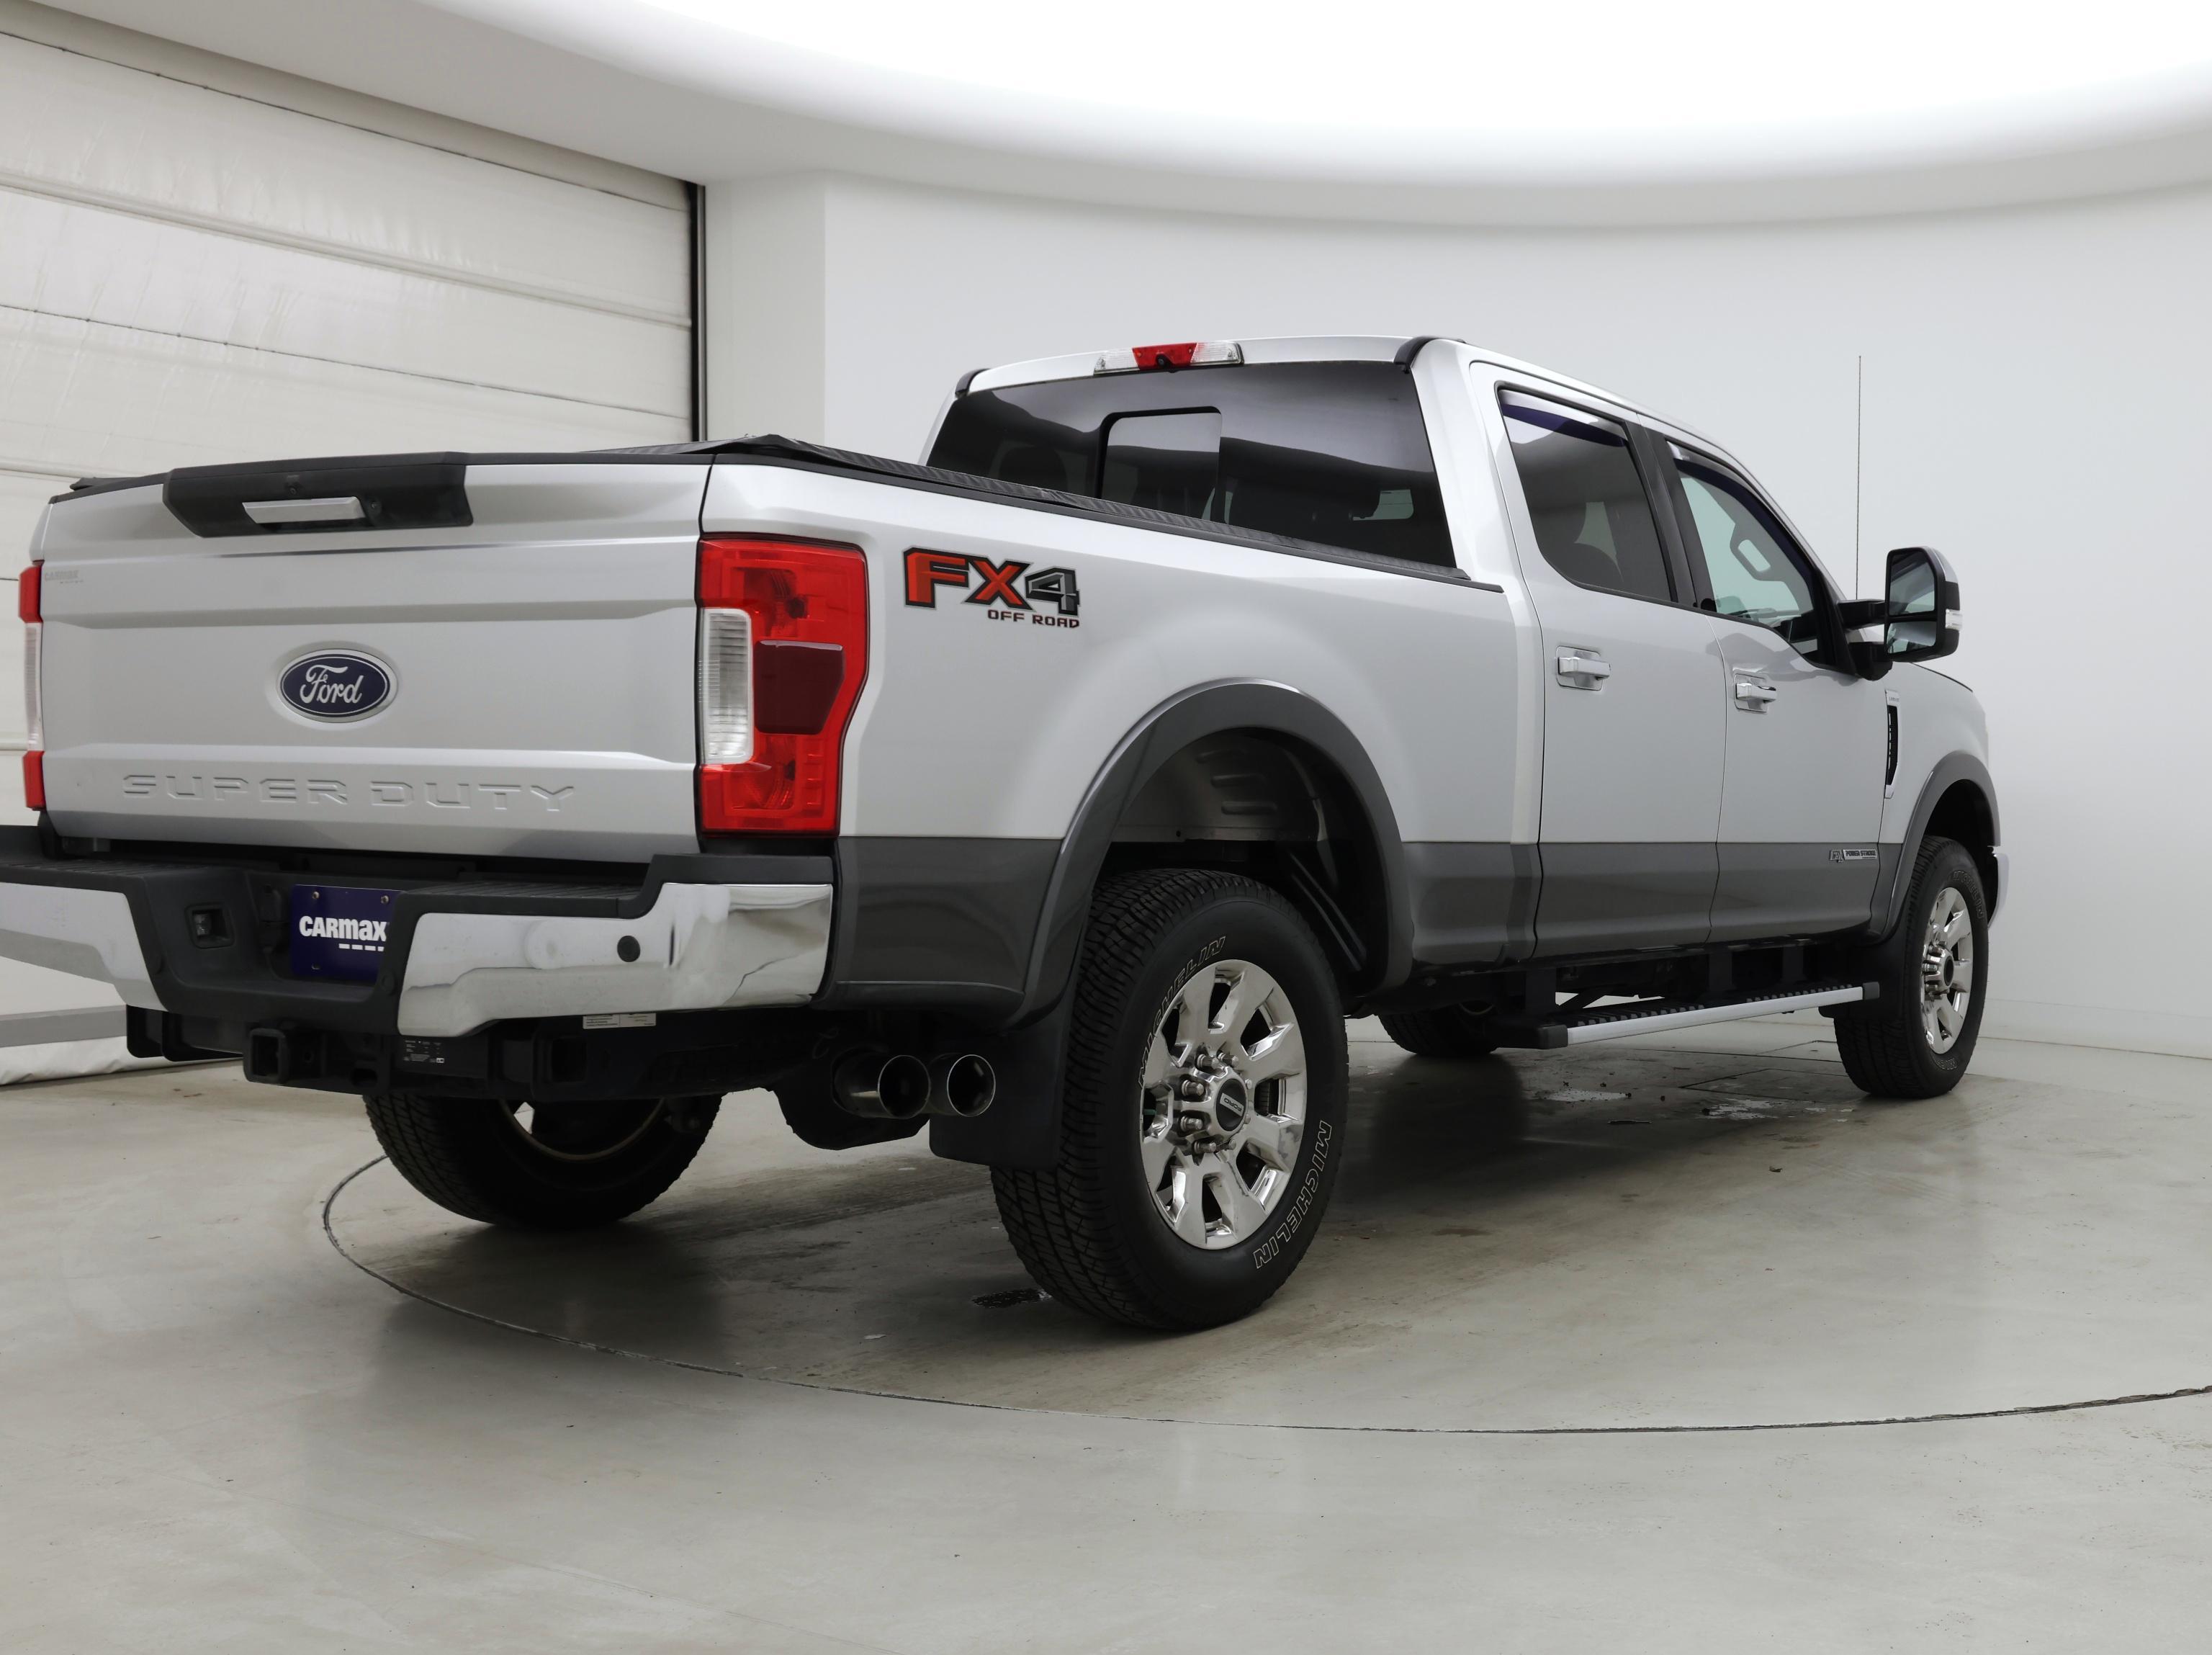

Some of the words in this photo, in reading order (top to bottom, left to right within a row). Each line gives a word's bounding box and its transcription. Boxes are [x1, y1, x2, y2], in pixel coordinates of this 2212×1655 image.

[903, 547, 1080, 616] FX4
[987, 609, 1025, 622] OFF
[1032, 614, 1080, 629] ROAD
[299, 663, 364, 707] Ford
[122, 773, 349, 807] SUPER
[371, 780, 575, 812] DUTY
[1223, 1098, 1242, 1112] FORD
[1252, 1120, 1332, 1270] MICHELIN
